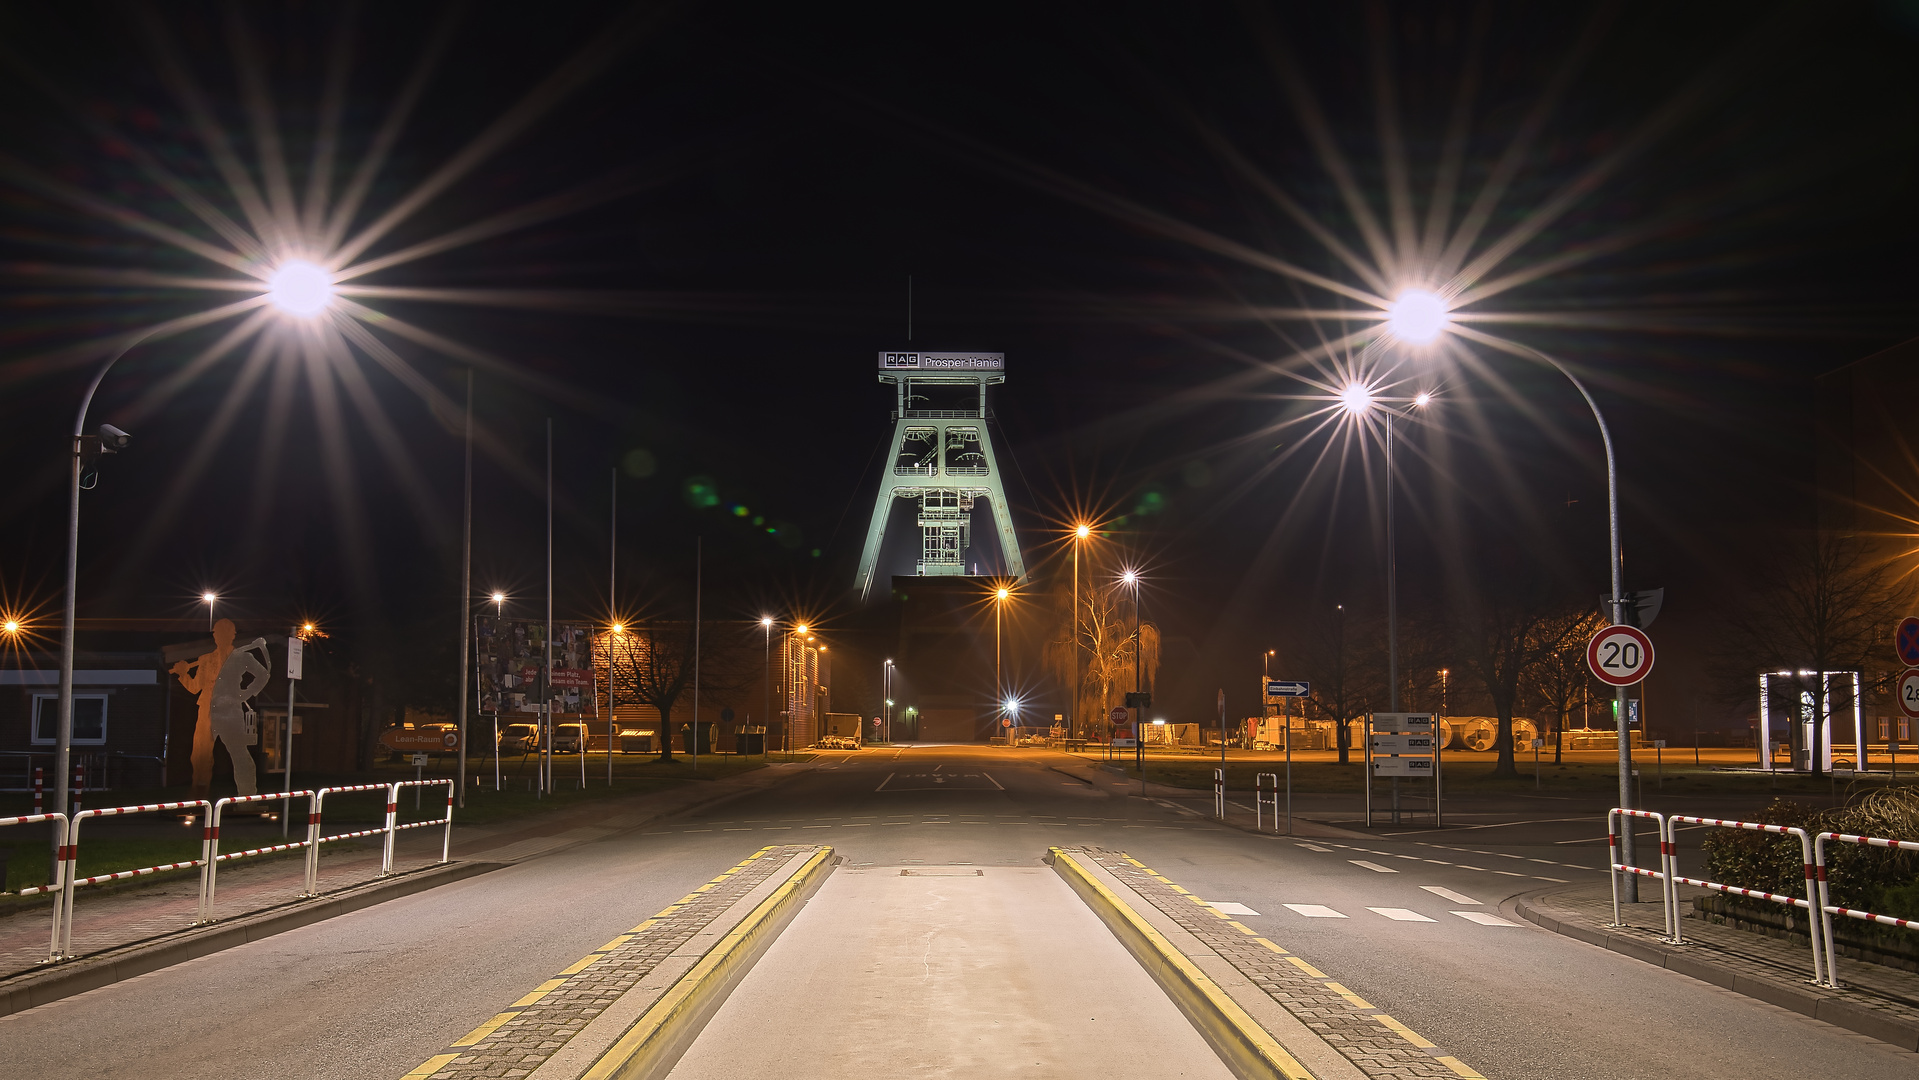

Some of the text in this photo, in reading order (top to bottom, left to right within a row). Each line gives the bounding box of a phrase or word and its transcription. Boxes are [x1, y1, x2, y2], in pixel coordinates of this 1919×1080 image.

[887, 355, 918, 364] RAG
[925, 357, 1001, 368] Prosper-Haniel
[1602, 641, 1639, 669] 20
[1111, 712, 1127, 720] STOP
[395, 735, 440, 743] Lean-Raum
